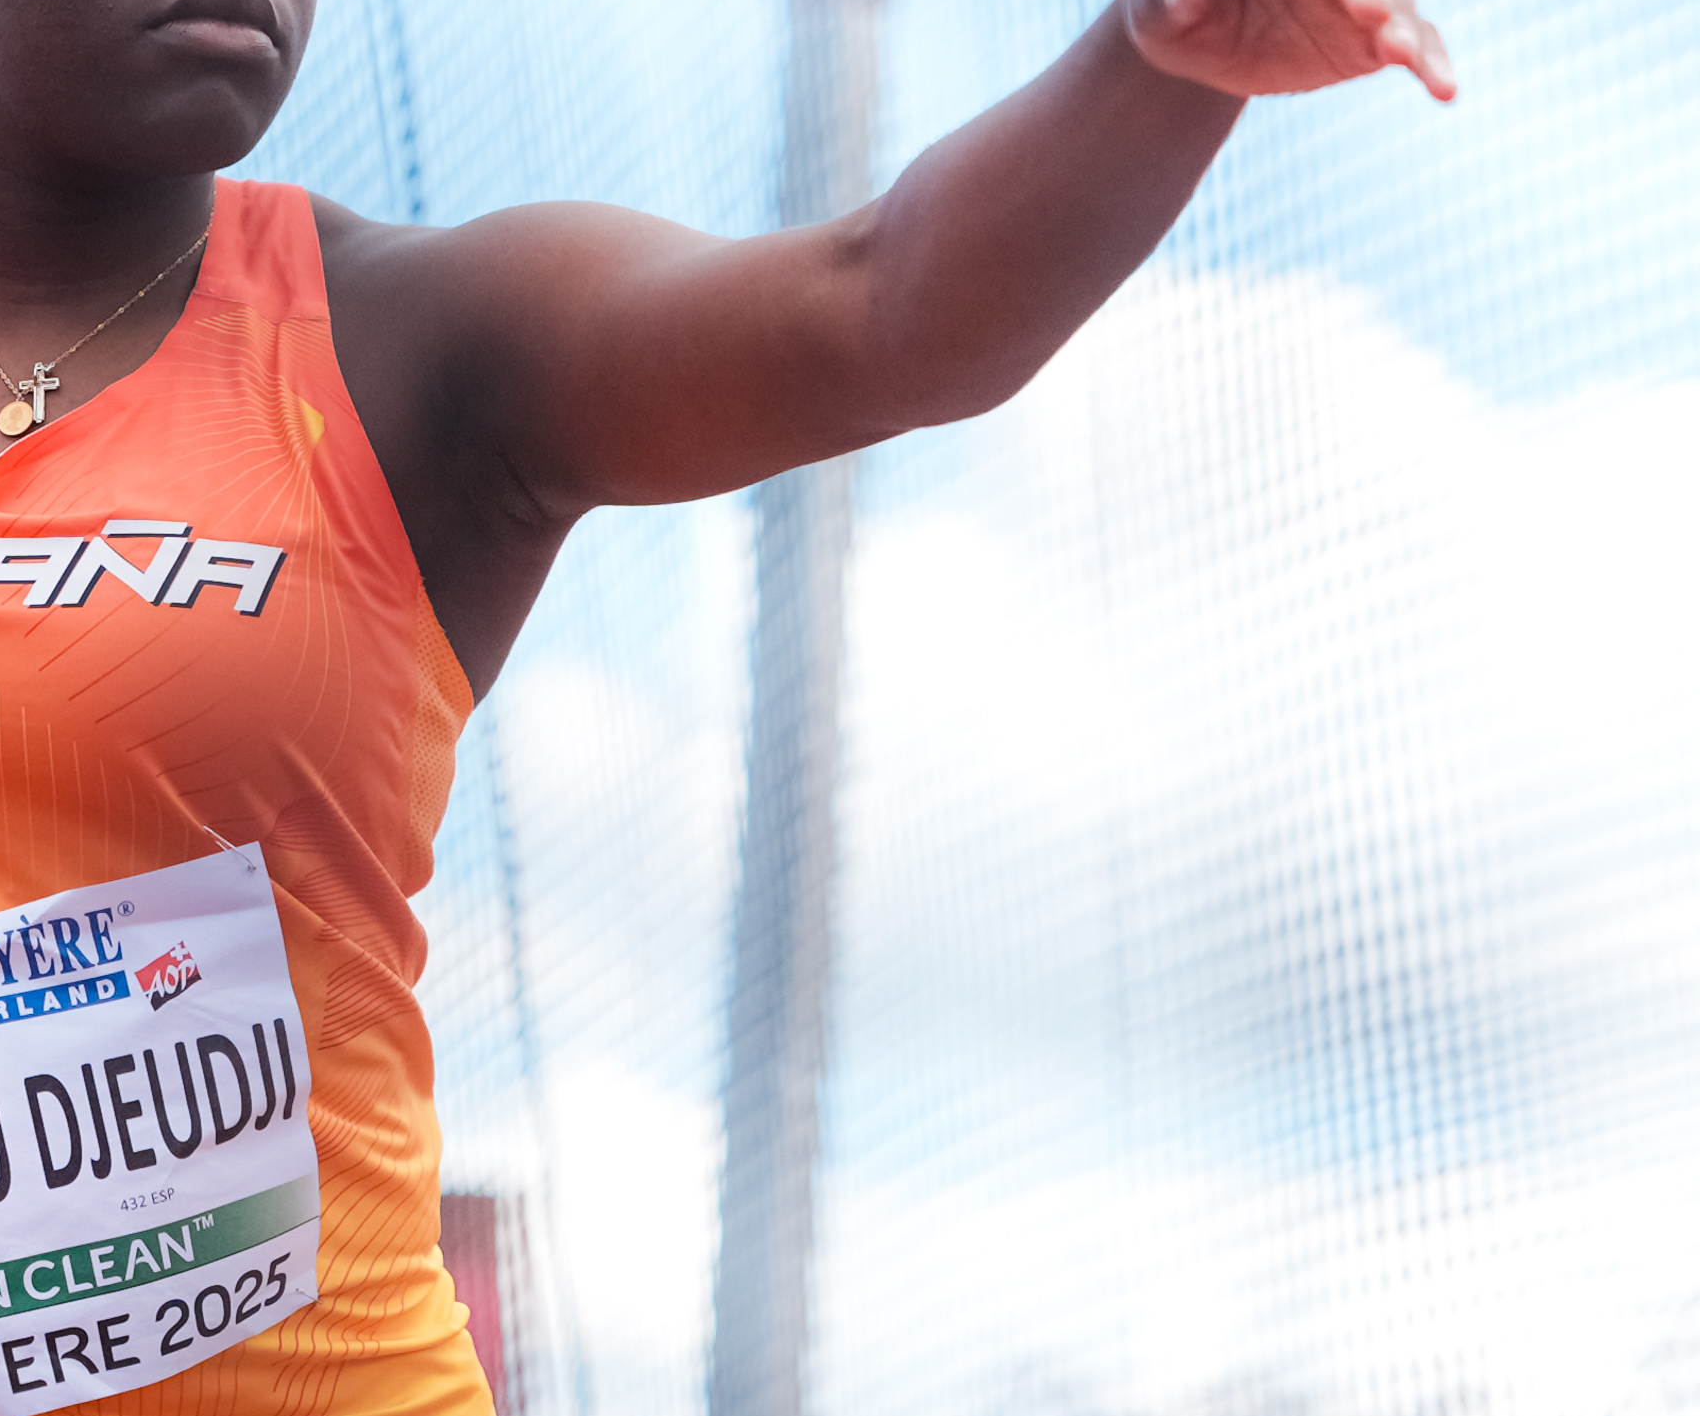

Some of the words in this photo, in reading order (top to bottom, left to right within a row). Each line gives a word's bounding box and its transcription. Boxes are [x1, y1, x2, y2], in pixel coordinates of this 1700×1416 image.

[23, 1017, 297, 1190] DJEUDJI
[120, 1194, 149, 1213] 432
[151, 1186, 176, 1205] ESP
[154, 1251, 292, 1358] 2025
